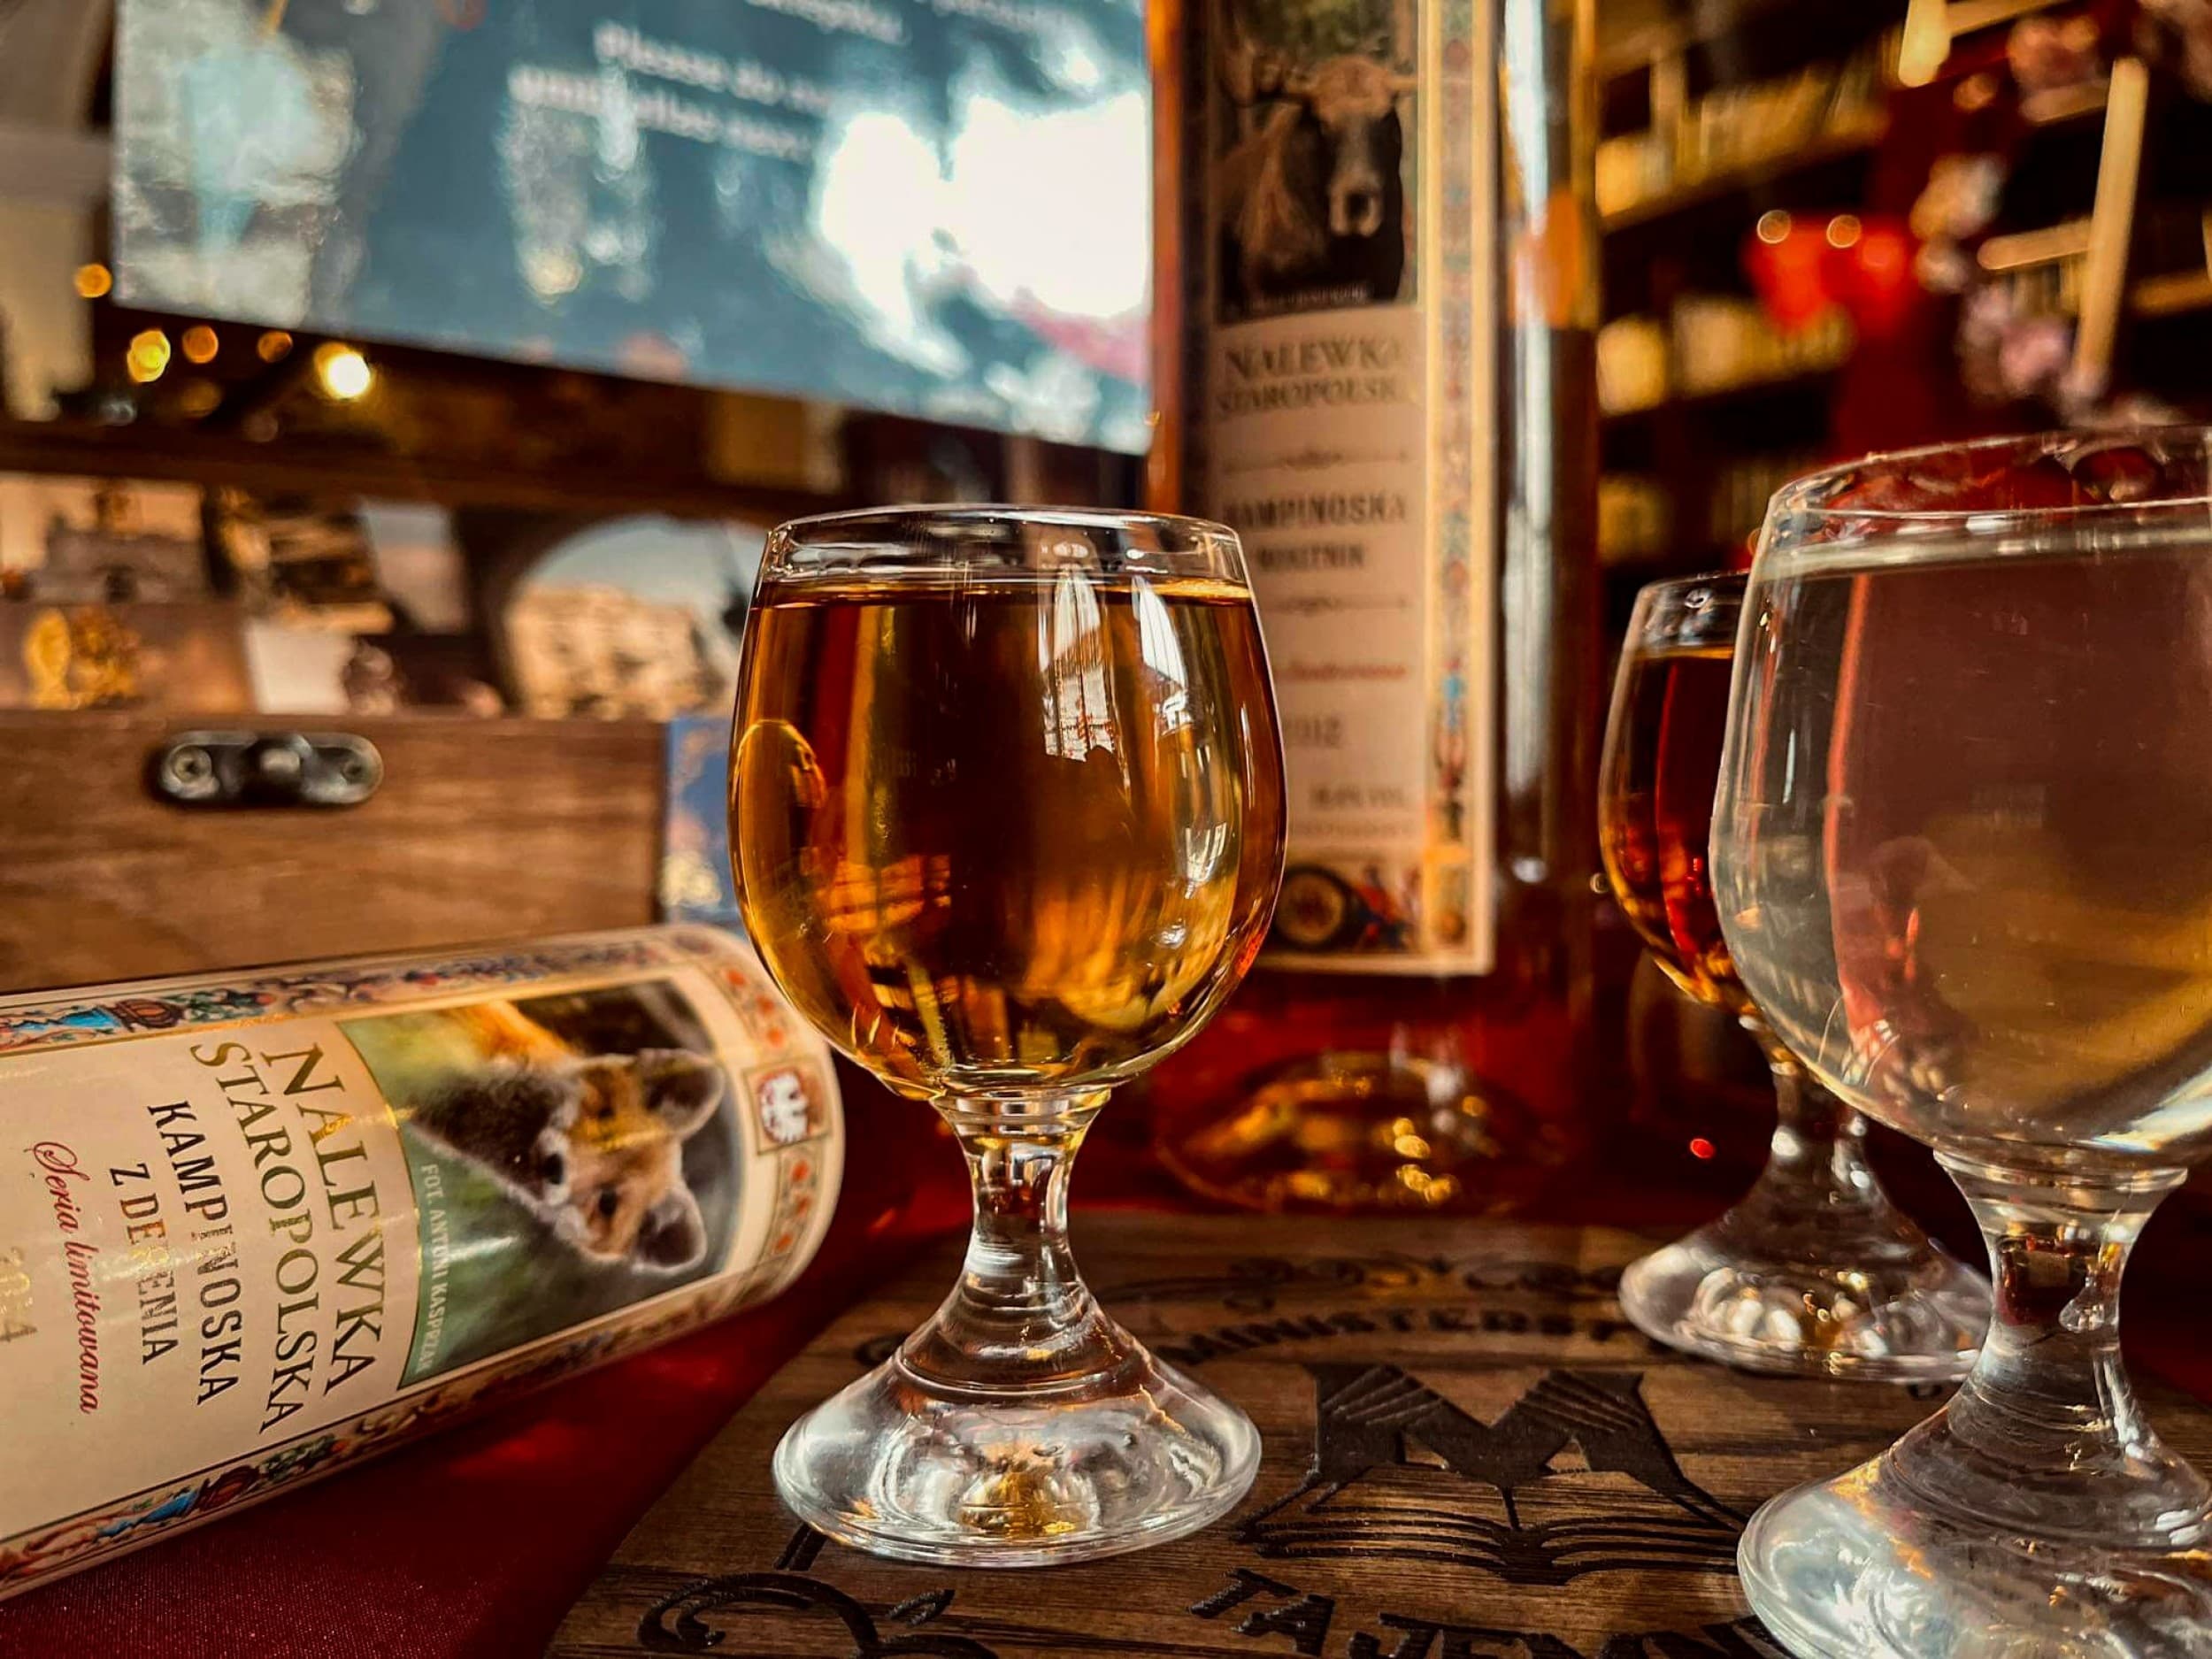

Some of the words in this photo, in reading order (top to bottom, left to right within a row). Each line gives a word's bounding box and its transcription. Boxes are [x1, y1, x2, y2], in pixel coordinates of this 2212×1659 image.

[25, 1141, 90, 1234] Seria
[64, 1240, 101, 1415] limitowana
[109, 1163, 151, 1187] Z
[119, 1193, 179, 1365] DEENIA
[147, 1100, 243, 1405] KAMPINOSKA
[189, 1042, 319, 1435] STAROPOLSKA
[260, 1042, 386, 1396] NALEWKA
[421, 1164, 442, 1204] FOT.
